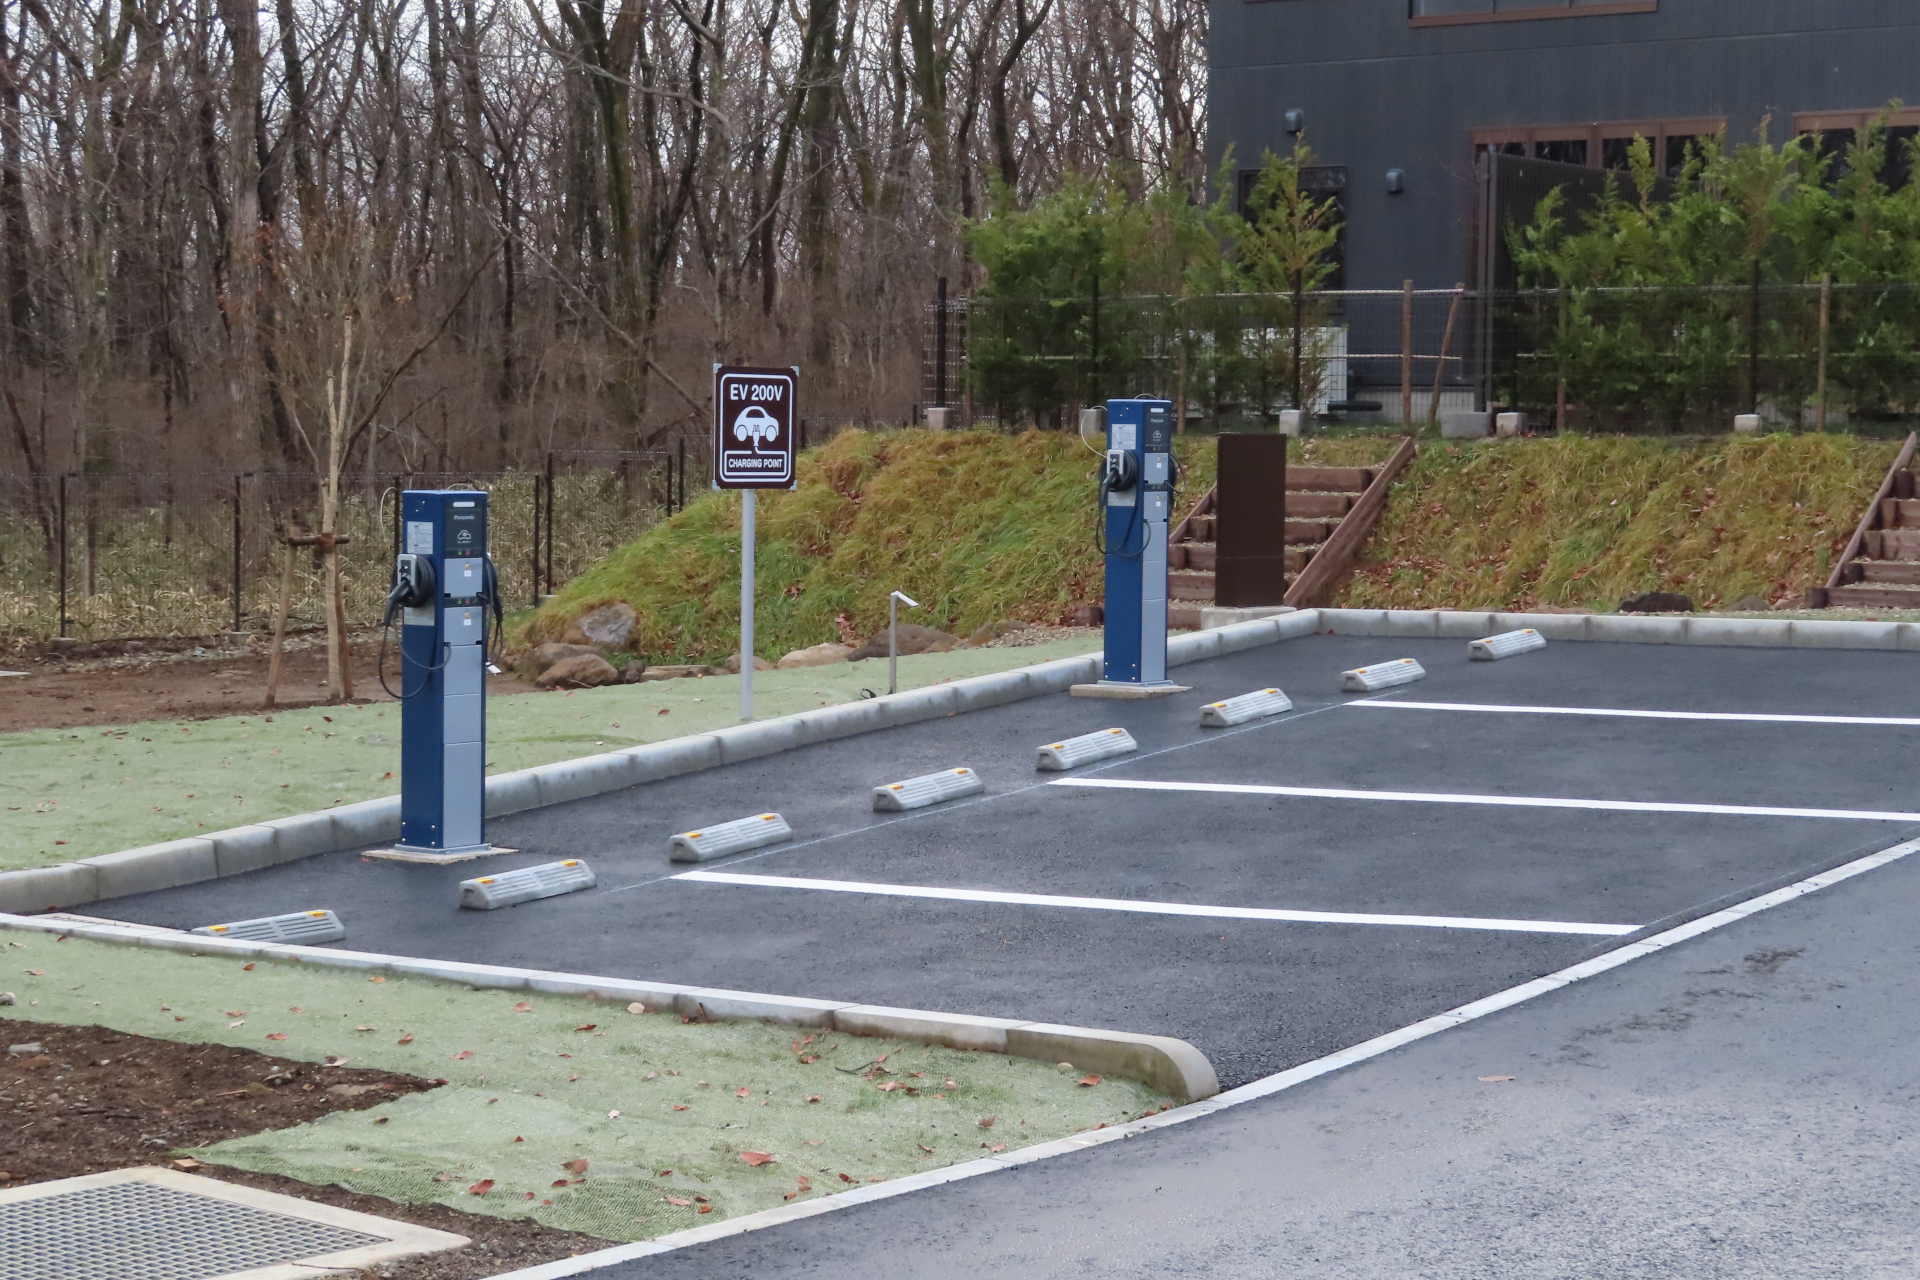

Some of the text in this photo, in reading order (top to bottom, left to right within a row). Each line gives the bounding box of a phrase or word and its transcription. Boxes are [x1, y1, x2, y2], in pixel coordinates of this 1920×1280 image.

[730, 384, 783, 401] EV 200V
[728, 458, 783, 468] CHARGING POINT
